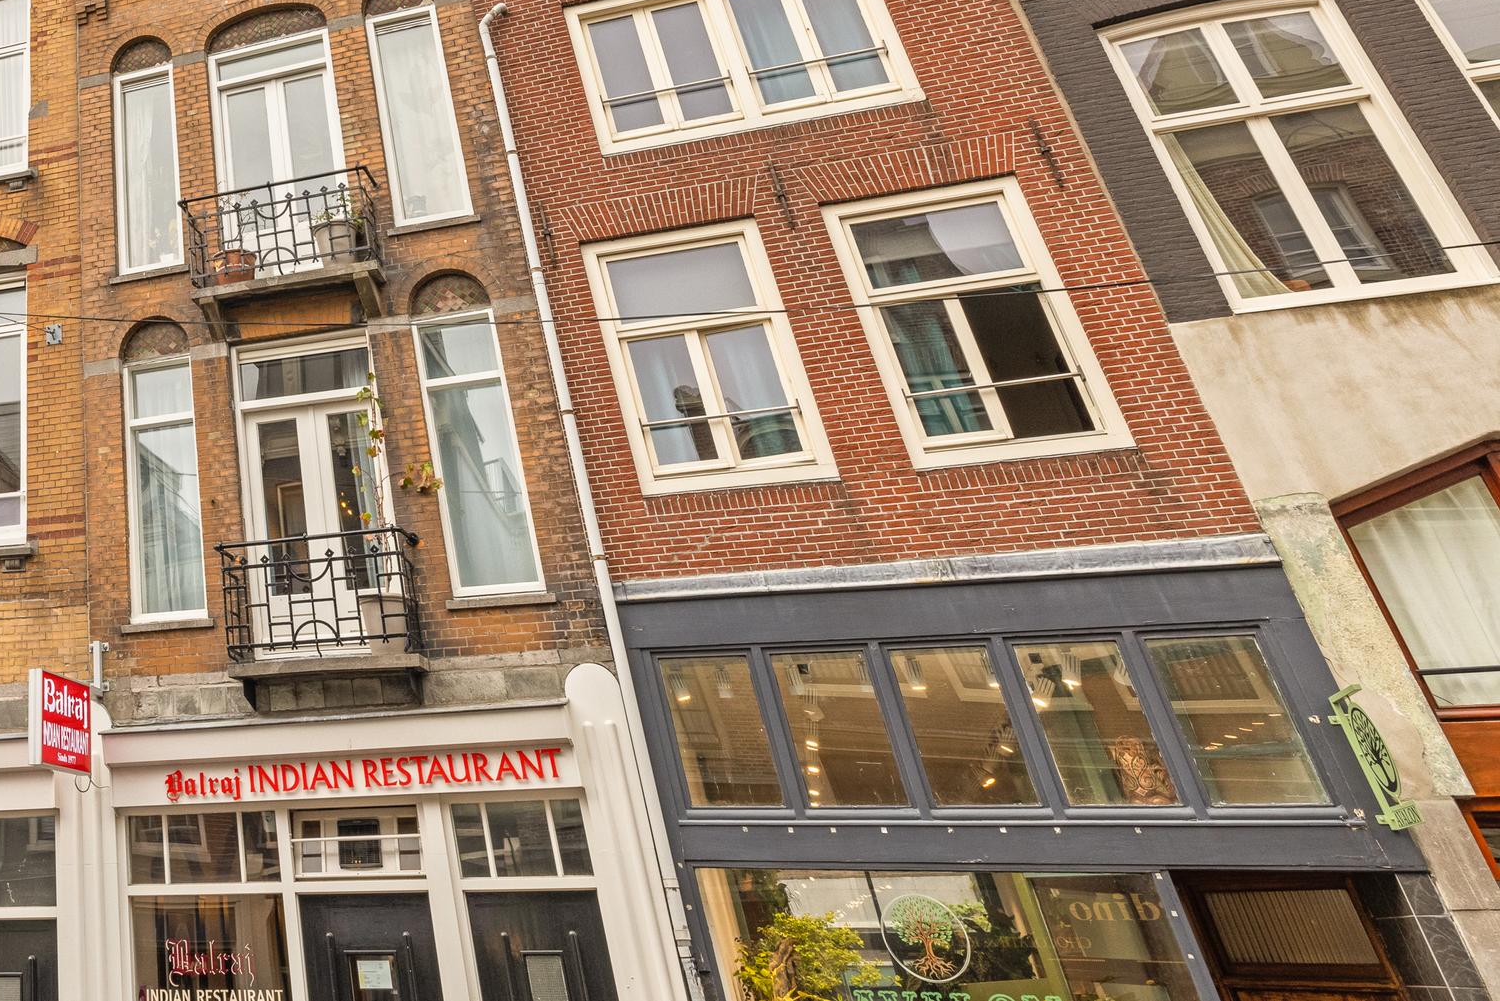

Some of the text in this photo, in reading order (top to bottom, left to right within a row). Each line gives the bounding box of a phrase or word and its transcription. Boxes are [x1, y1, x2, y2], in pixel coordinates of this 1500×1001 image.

[43, 677, 88, 729] Balraj
[43, 720, 89, 756] INDIAN RESTAURANT
[164, 747, 562, 803] Balraj INDIAN RESTAURANT
[1394, 805, 1421, 827] AVALON
[165, 938, 256, 988] Balraj
[146, 988, 283, 1001] INDIAN RESTAURANT
